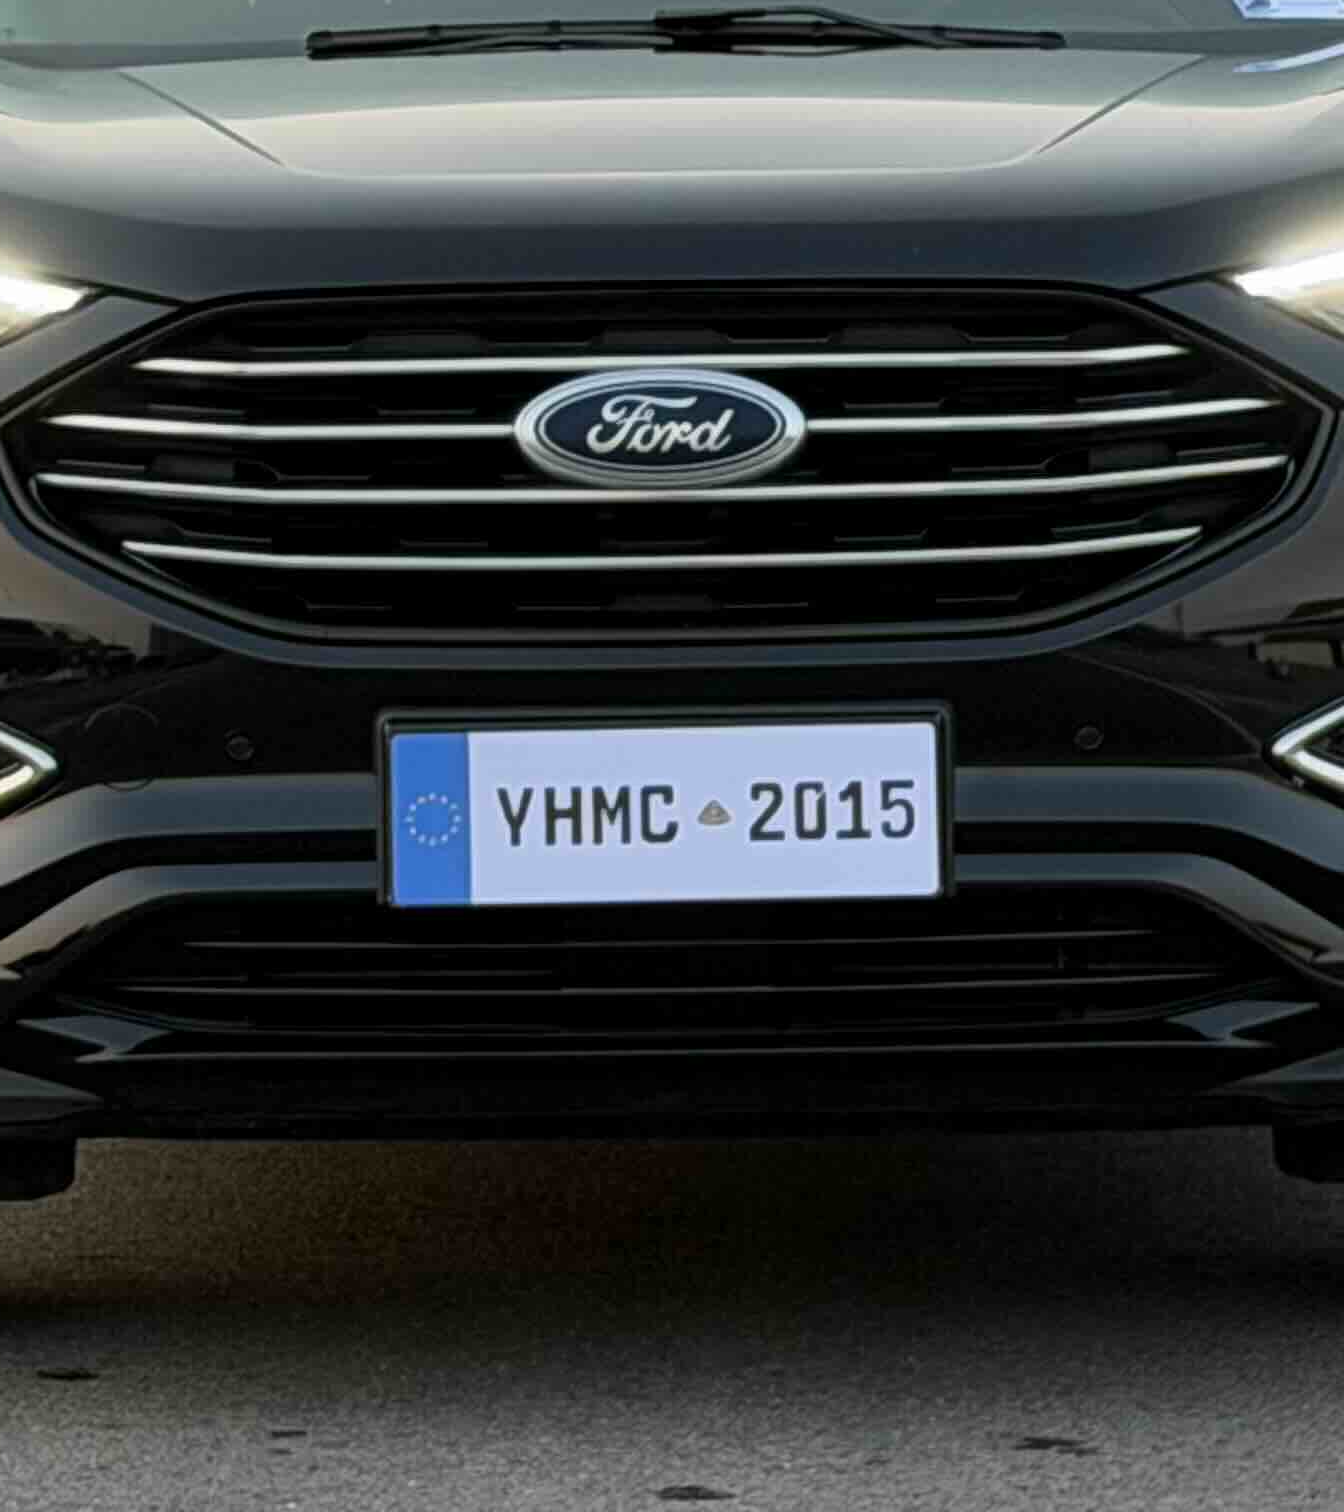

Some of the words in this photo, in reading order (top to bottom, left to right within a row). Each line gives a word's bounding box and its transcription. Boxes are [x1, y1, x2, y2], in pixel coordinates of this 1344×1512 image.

[586, 393, 734, 453] Ford
[497, 786, 679, 847] YHMC
[749, 780, 916, 841] 2015
